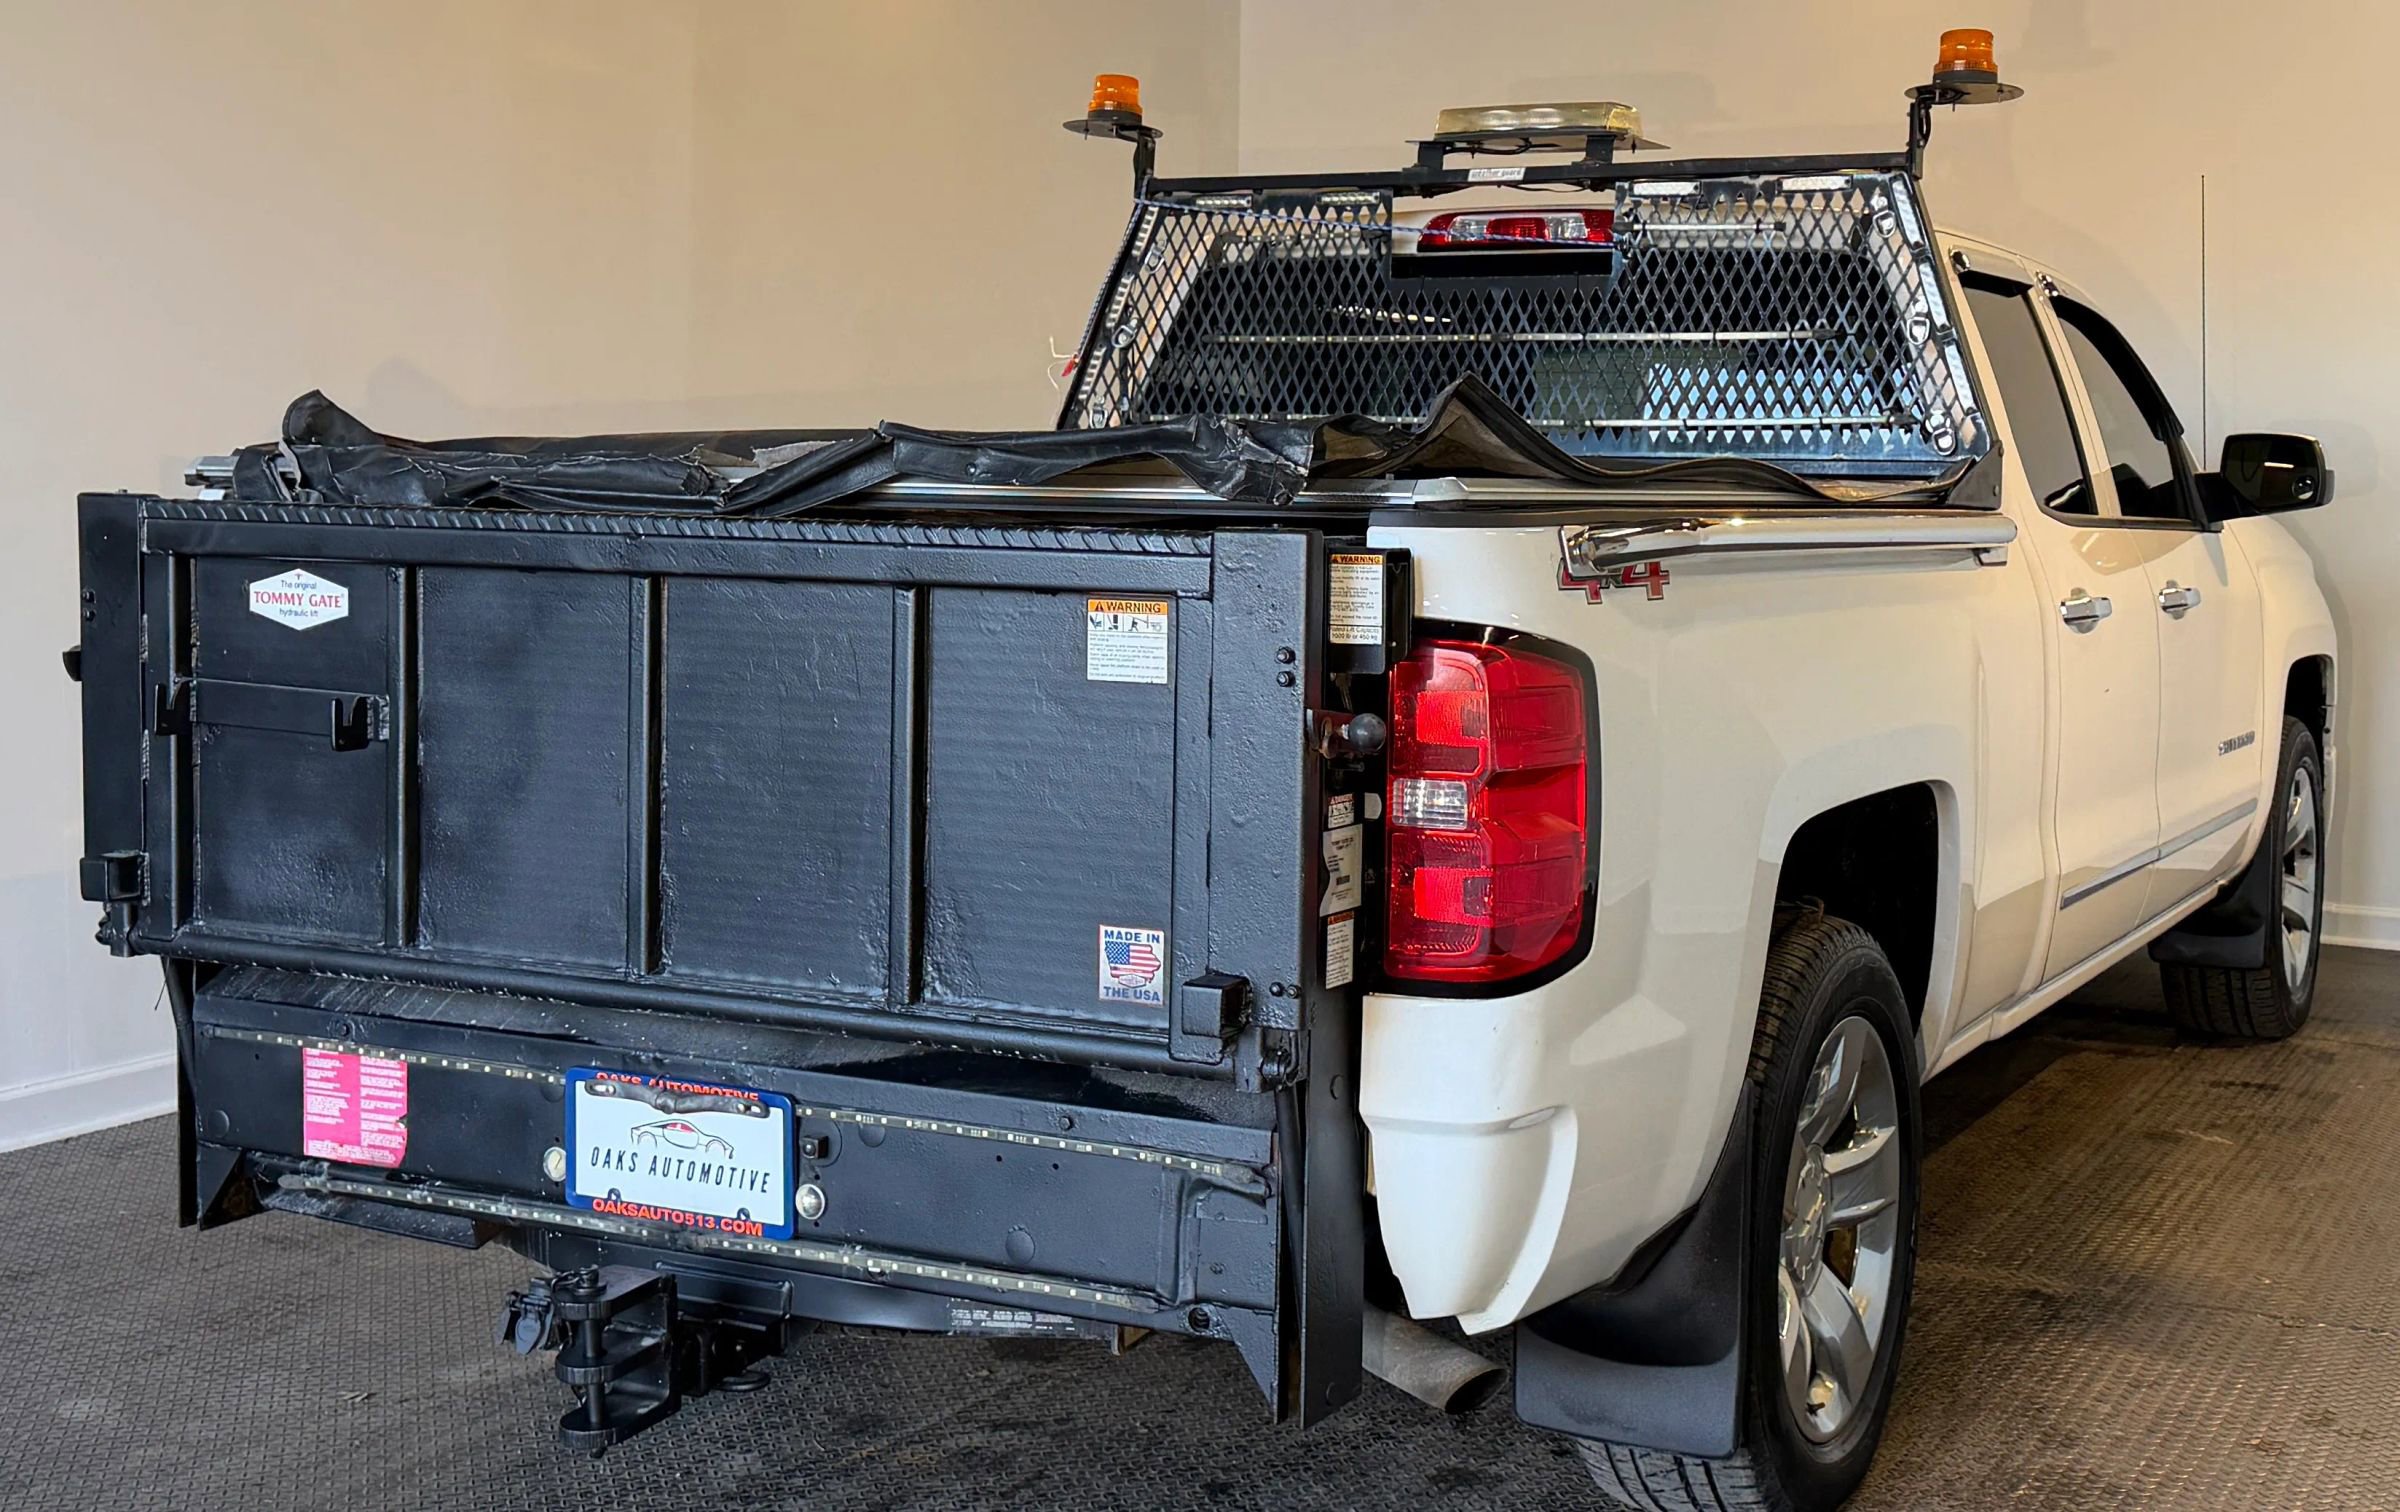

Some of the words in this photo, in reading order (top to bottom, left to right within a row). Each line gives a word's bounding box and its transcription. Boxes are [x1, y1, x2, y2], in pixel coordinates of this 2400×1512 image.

[1340, 555, 1381, 564] WARNING
[281, 580, 292, 588] The
[294, 582, 317, 591] original
[254, 591, 304, 606] TOMMY
[309, 594, 342, 608] GATE
[1106, 601, 1161, 613] WARNING
[279, 608, 308, 617] hydraulic
[1104, 929, 1142, 942] MADE
[1147, 933, 1160, 944] IN
[1103, 986, 1129, 998] THE
[1133, 989, 1160, 1002] USA
[591, 1146, 638, 1173] OAKS
[649, 1155, 770, 1194] AUTOMOTIVE
[592, 1199, 764, 1237] OAKSAUTO513.COM
